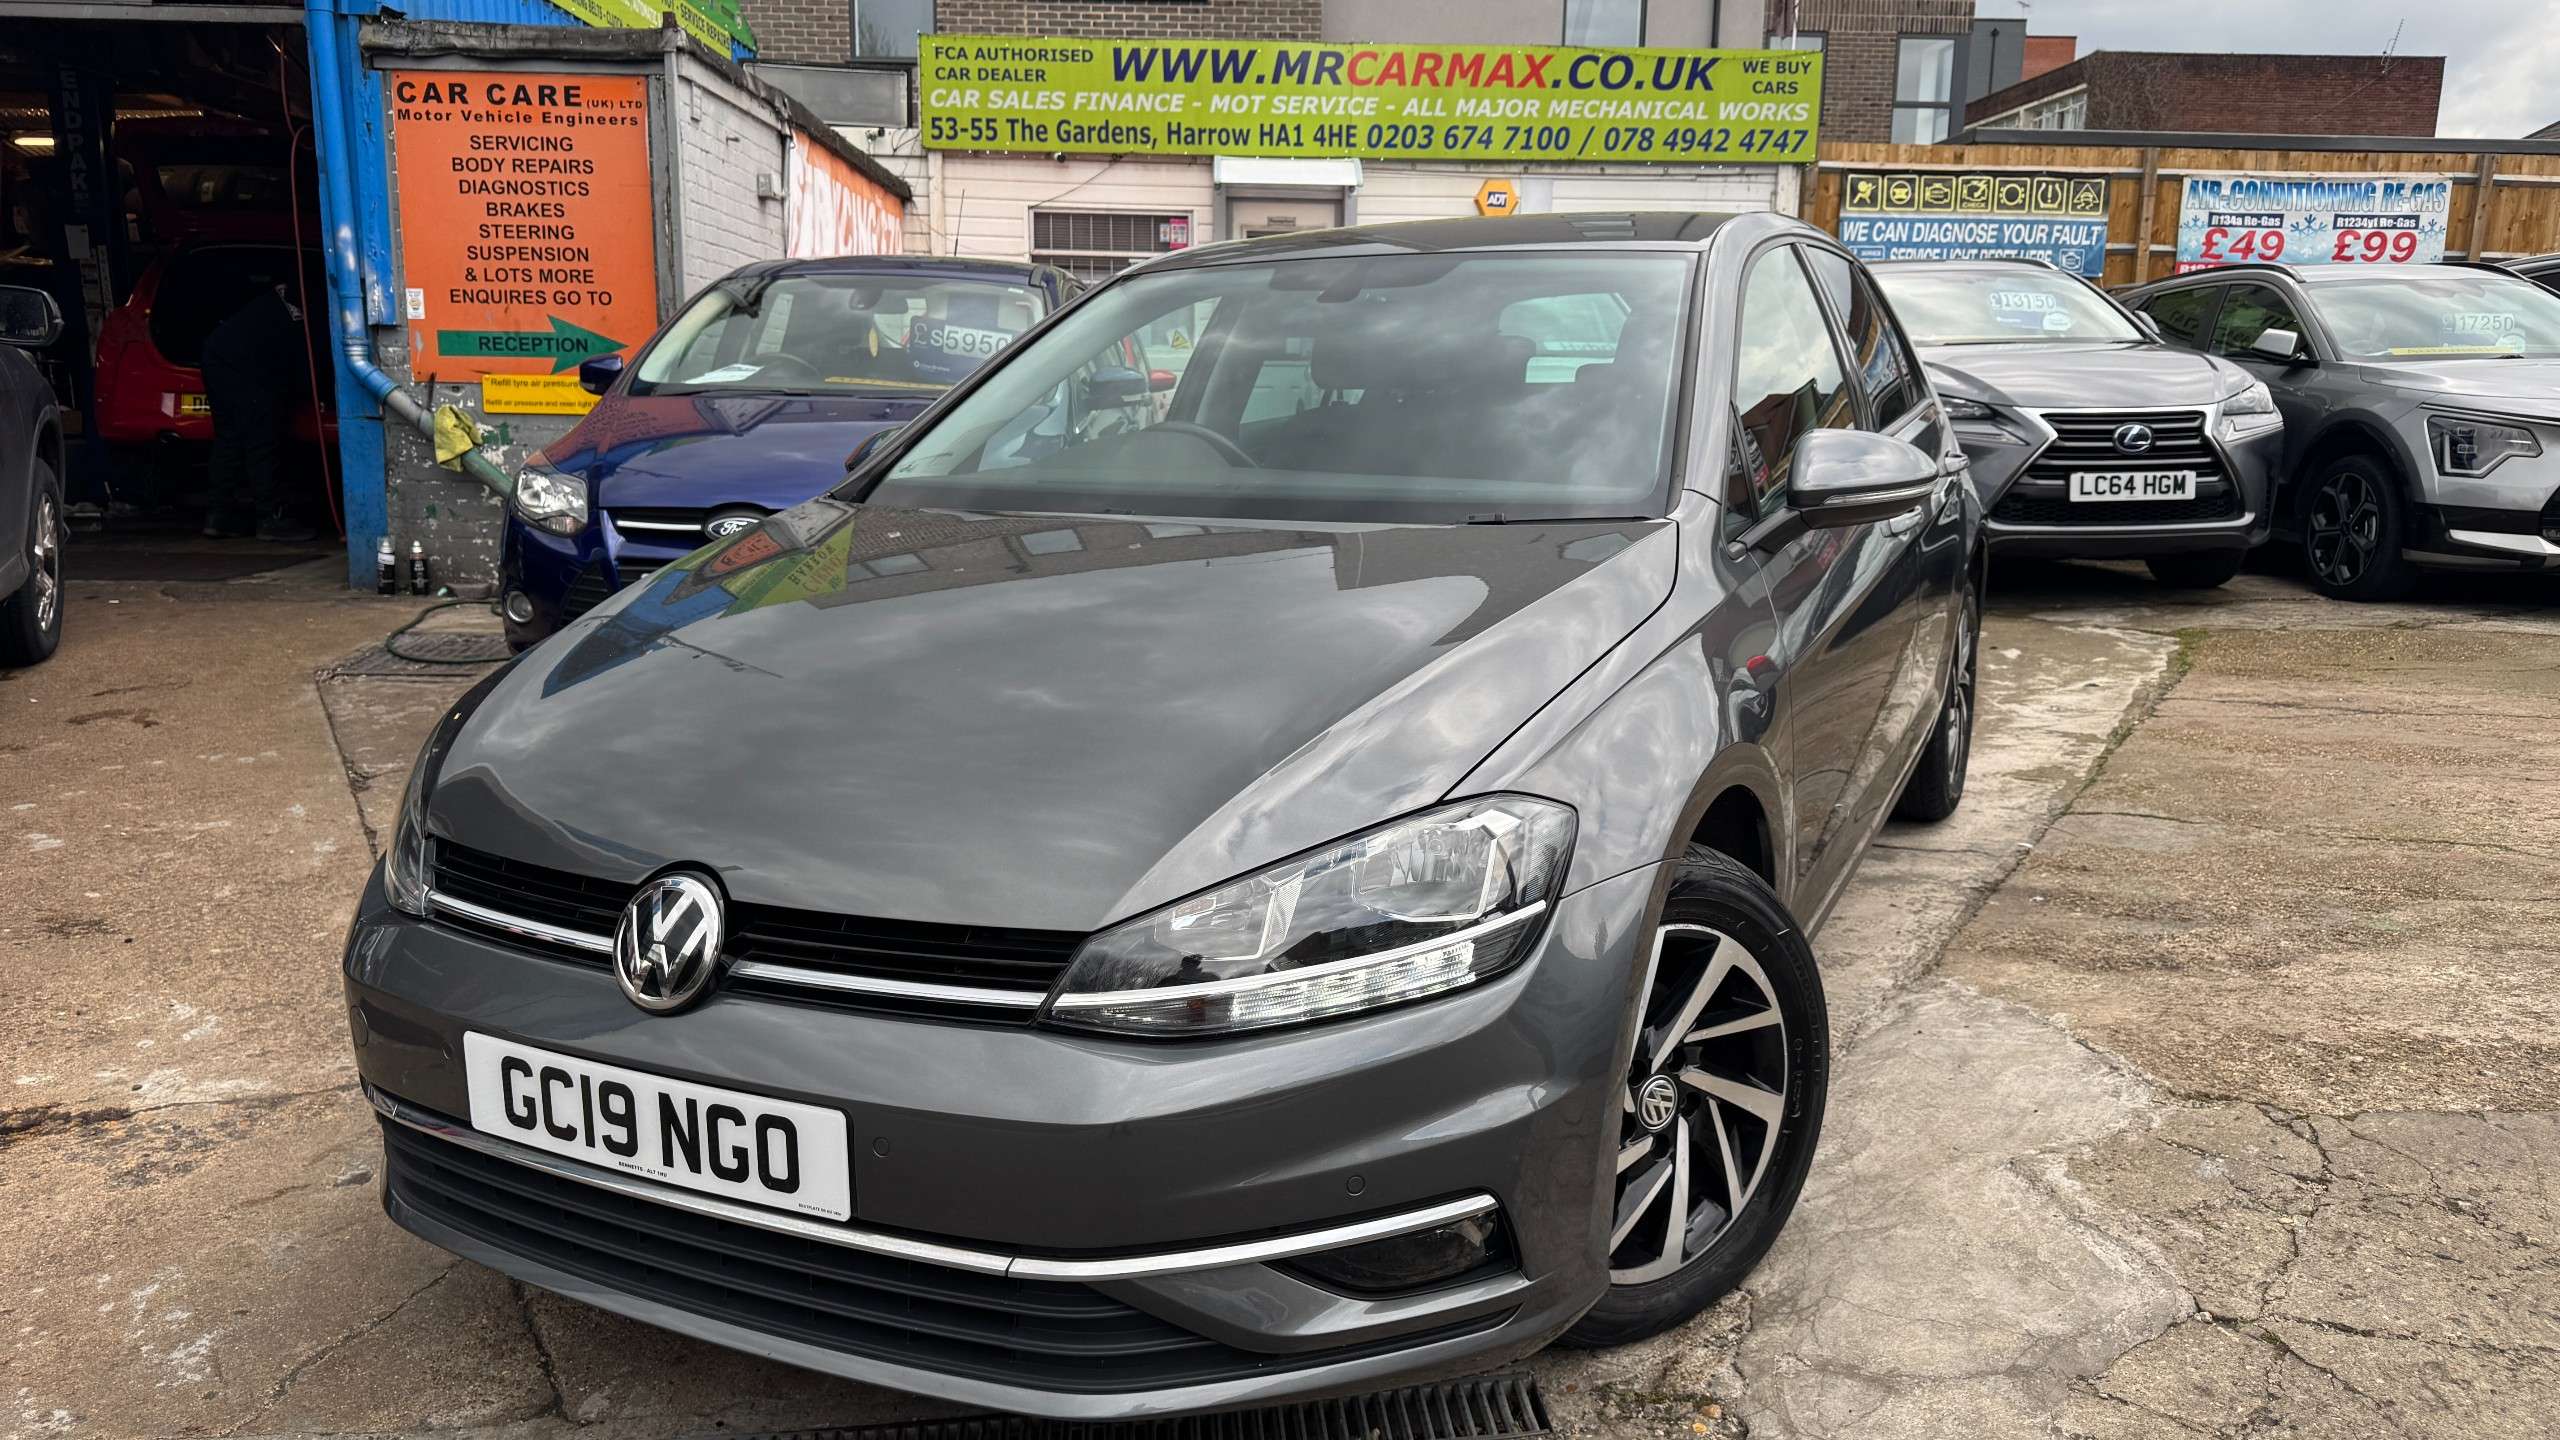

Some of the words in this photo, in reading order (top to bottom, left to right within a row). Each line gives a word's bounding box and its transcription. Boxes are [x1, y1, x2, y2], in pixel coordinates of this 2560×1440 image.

[934, 46, 969, 61] FCA
[974, 46, 1094, 63] AUTHORISED
[934, 66, 972, 81] CAR
[977, 66, 1047, 82] DEALER
[1112, 46, 1722, 92] WWW.MRCARMAX.CO.UK
[1742, 60, 1772, 75] WE
[1776, 60, 1812, 75] BUY
[397, 81, 469, 105] CAR
[486, 83, 582, 107] CARE
[586, 98, 614, 110] (UK)
[619, 99, 643, 110] LTD
[1752, 80, 1799, 95] CARS
[930, 89, 980, 108] CAR
[986, 89, 1065, 110] SALES
[1073, 91, 1186, 113] FINANCE
[1209, 94, 1267, 114] MOT
[1270, 94, 1379, 116] SERVICE
[1402, 97, 1448, 118] ALL
[1455, 97, 1541, 119] MAJOR
[1547, 99, 1709, 120] MECHANICAL
[1717, 101, 1810, 122] WORKS
[397, 108, 451, 122] Motor
[461, 110, 532, 124] Vehicle
[542, 111, 639, 128] Engineers
[470, 134, 574, 152] SERVICING
[930, 116, 998, 143] 53-55
[1005, 117, 1048, 144] The
[1056, 118, 1158, 150] Gardens,
[1166, 121, 1250, 147] Harrow
[1258, 123, 1304, 148] HA1
[1312, 124, 1357, 149] 4HE
[1367, 124, 1434, 150] 0203
[1442, 125, 1493, 150] 674
[1503, 126, 1570, 152] 7100
[1577, 126, 1597, 156] /
[1603, 126, 1655, 152] 078
[1662, 127, 1731, 153] 4942
[1738, 128, 1810, 155] 4747
[452, 156, 506, 173] BODY
[512, 157, 594, 175] REPAIRS
[459, 179, 590, 197] DIAGNOSTICS
[2186, 179, 2378, 213] AIR-CONDITIONING
[2380, 181, 2448, 214] RE-GAS
[486, 201, 566, 218] BRAKES
[1488, 193, 1507, 207] ADT
[2244, 215, 2281, 227] Re-Gas
[2380, 217, 2417, 229] Re-Gas
[479, 223, 575, 241] STEERING
[1842, 221, 1869, 242] WE
[1871, 221, 1909, 243] CAN
[1912, 222, 2000, 244] DIAGNOSE
[2002, 224, 2051, 245] YOUR
[2050, 224, 2103, 246] FAULT
[2200, 226, 2286, 262] £49
[2330, 228, 2418, 264] £99
[467, 245, 589, 263] SUSPENSION
[464, 267, 478, 283] &
[484, 267, 533, 284] LOTS
[539, 268, 595, 285] MORE
[450, 288, 546, 306] ENQUIRES
[553, 289, 582, 306] GO
[588, 290, 613, 307] TO
[478, 335, 589, 354] RECEPTION
[2079, 475, 2137, 496] LC64
[2143, 474, 2187, 495] HGM
[500, 1055, 640, 1158] GC19
[658, 1091, 801, 1195] NGO
